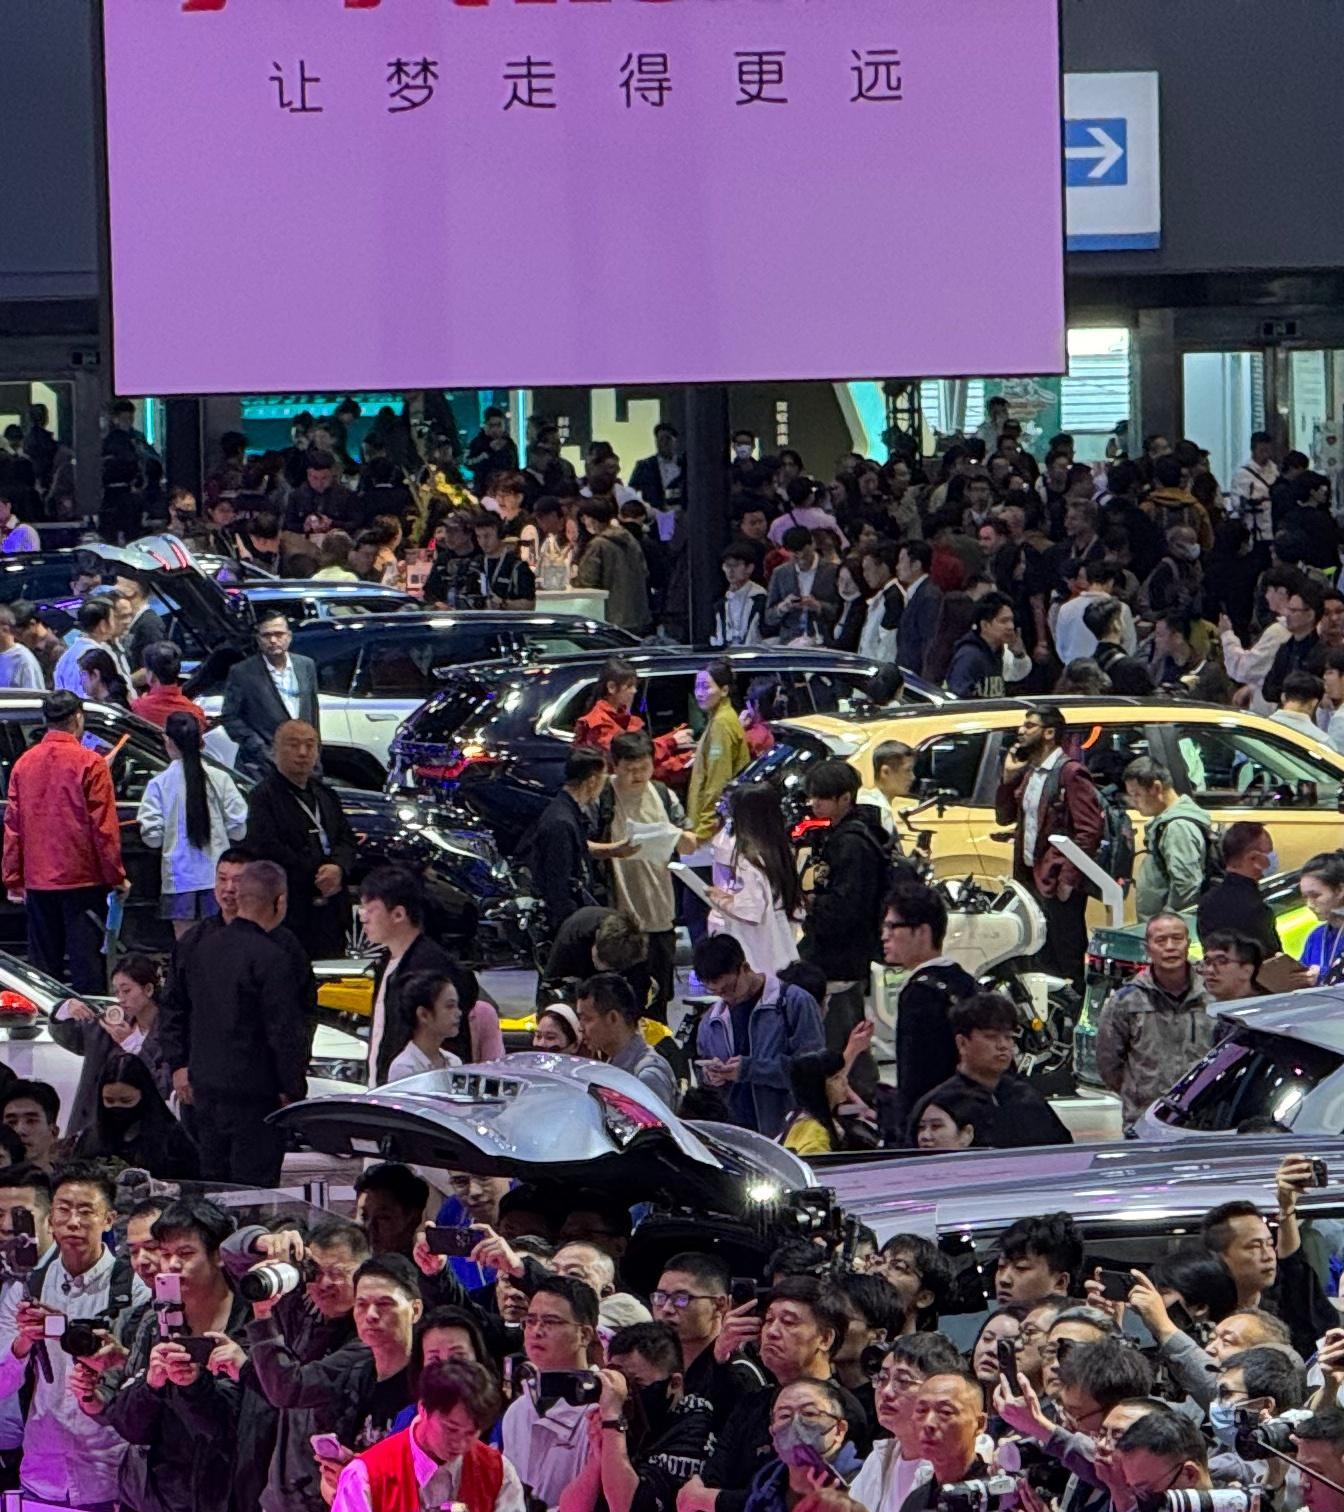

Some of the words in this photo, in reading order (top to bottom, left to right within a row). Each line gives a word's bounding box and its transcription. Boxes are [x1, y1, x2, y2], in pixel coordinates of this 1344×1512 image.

[269, 48, 904, 114] 让梦走得更远
